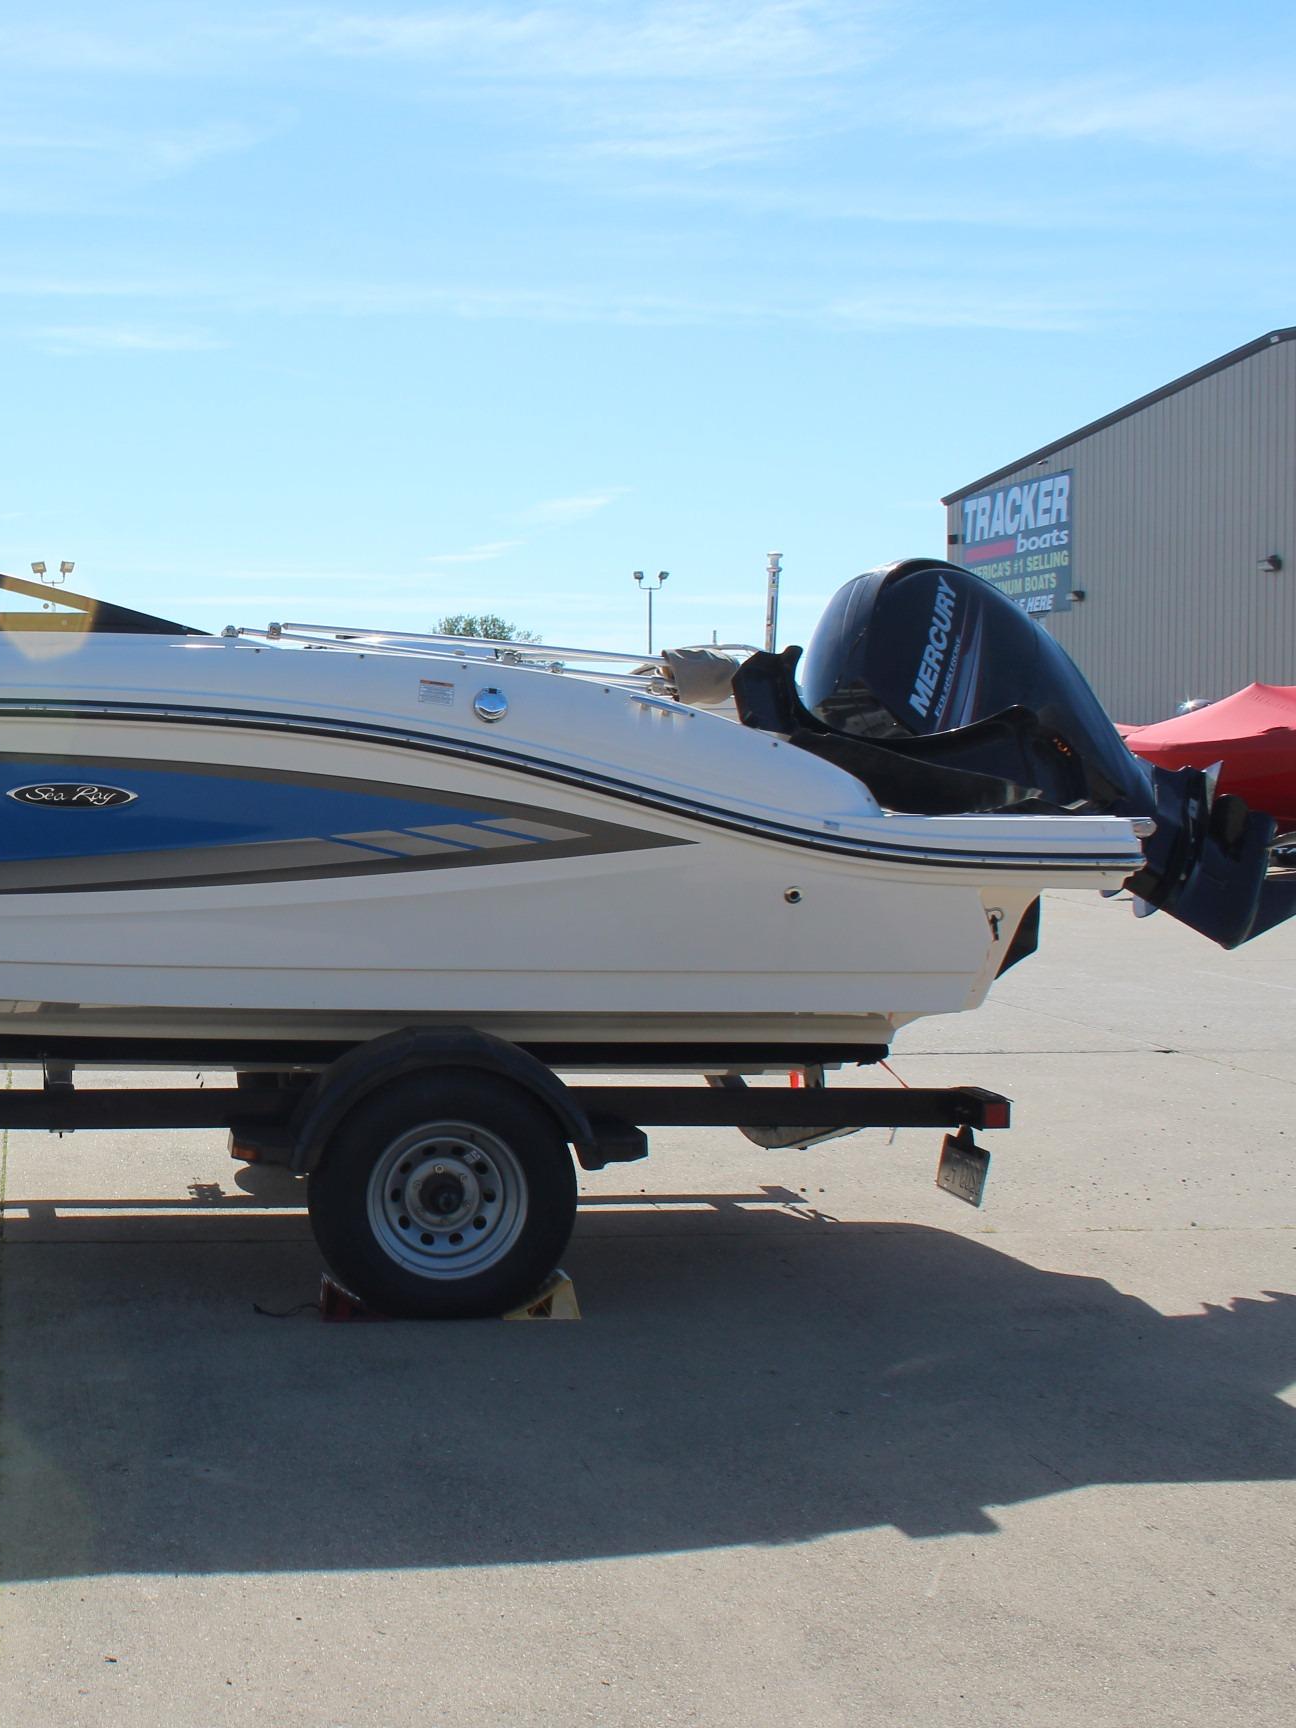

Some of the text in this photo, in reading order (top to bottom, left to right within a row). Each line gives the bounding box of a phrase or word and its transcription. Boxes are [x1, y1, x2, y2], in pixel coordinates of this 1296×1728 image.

[964, 475, 1070, 543] TRACKER
[1016, 529, 1068, 553] boats
[1026, 550, 1070, 572] SELLING
[1024, 573, 1057, 592] BOATS
[909, 576, 956, 718] MERCURY
[26, 786, 117, 806] Sea Ray
